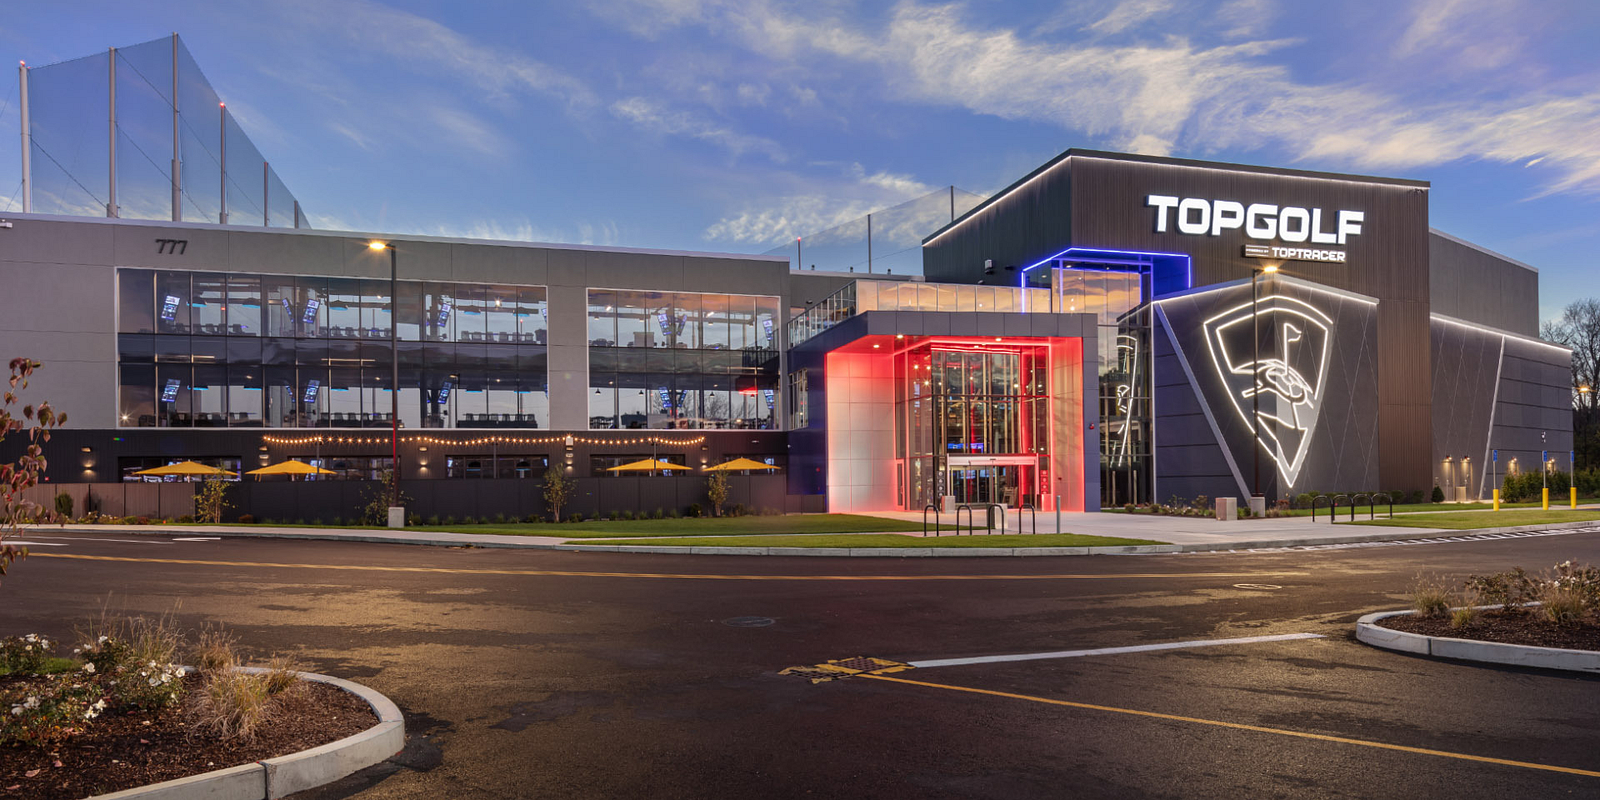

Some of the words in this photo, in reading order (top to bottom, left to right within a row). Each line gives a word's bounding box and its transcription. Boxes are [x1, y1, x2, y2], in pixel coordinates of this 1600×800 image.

[1147, 195, 1364, 244] TOPGOLF
[155, 238, 189, 255] 777
[1271, 246, 1346, 262] TOPTRACER
